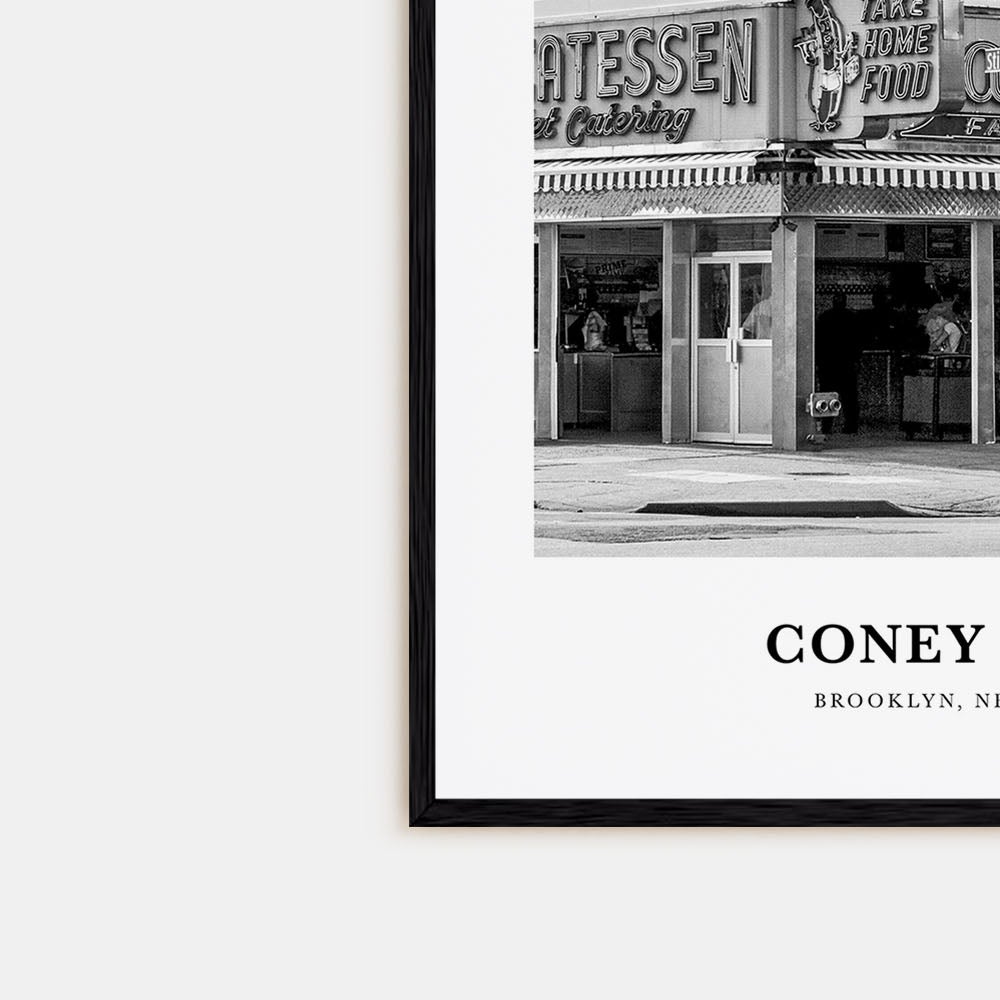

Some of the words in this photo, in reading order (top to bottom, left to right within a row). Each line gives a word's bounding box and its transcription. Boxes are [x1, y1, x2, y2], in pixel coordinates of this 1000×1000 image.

[537, 18, 757, 105] ATESSEN
[862, 23, 936, 58] HOME
[860, 61, 932, 103] FOOD
[566, 100, 696, 146] Catering
